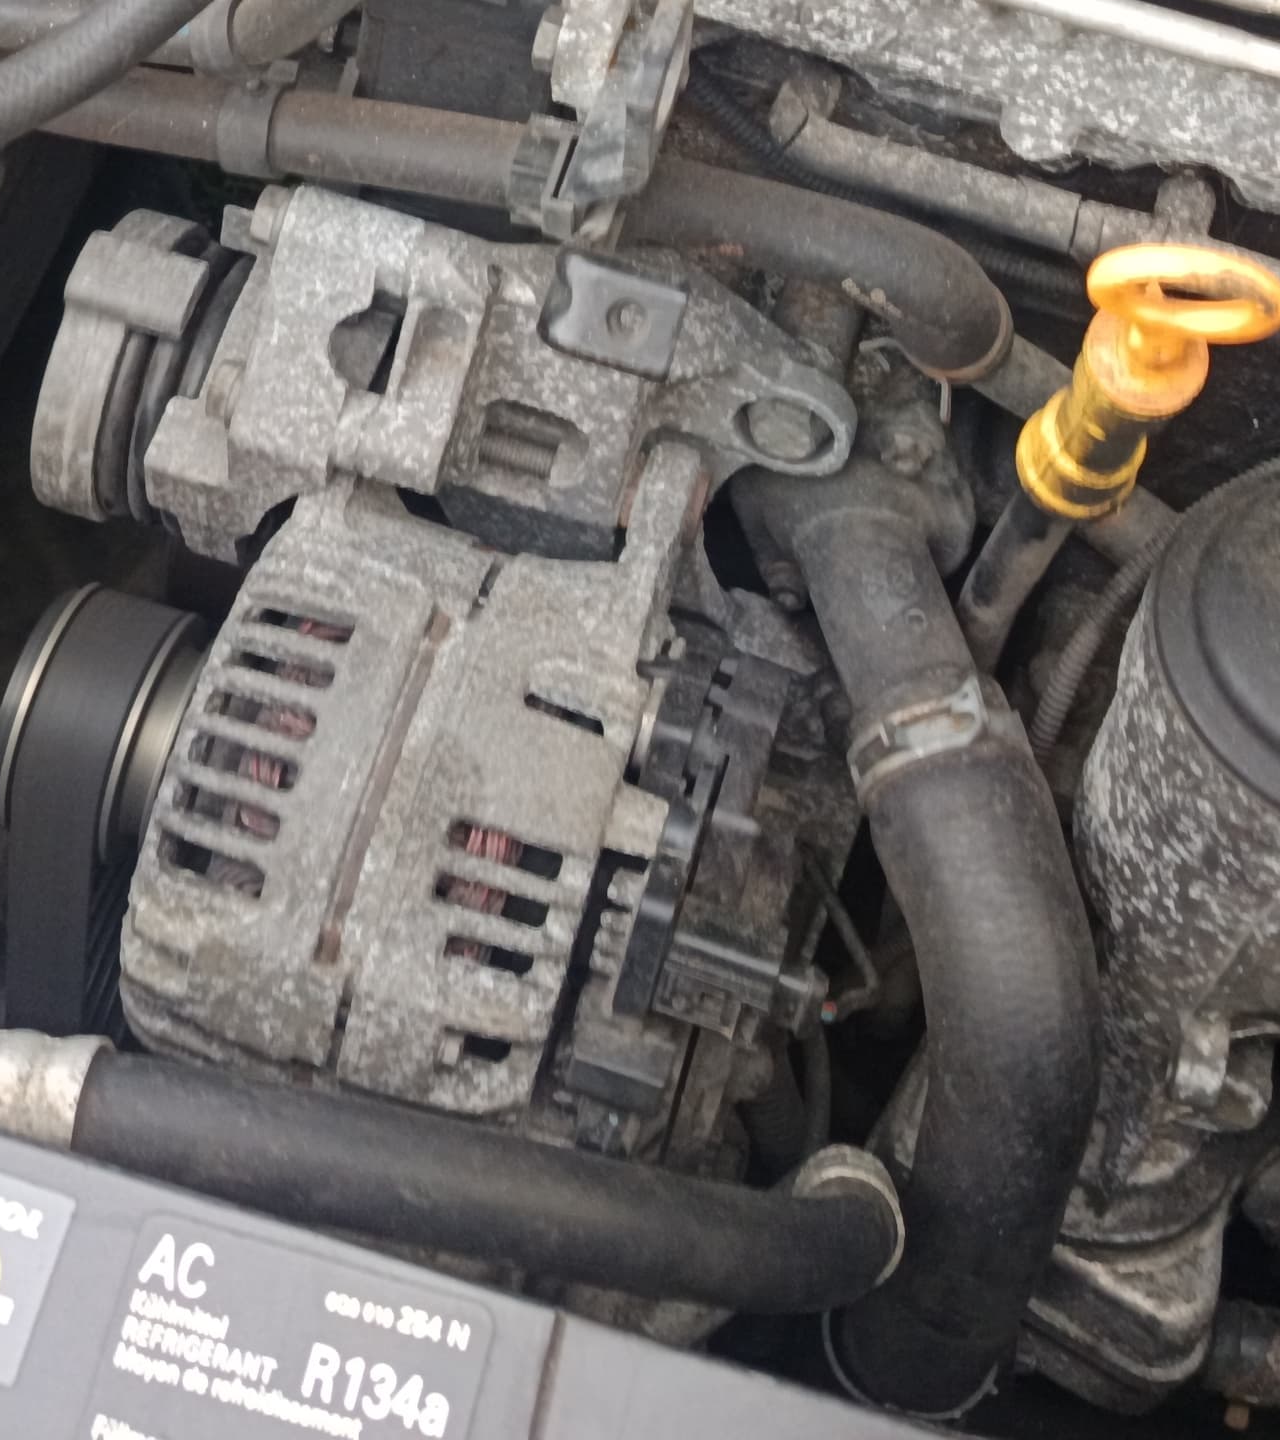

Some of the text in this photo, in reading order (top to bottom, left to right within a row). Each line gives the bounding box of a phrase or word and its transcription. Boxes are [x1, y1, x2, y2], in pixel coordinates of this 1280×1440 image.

[138, 1233, 215, 1299] AC
[113, 1341, 181, 1386] Moyen
[182, 1366, 209, 1395] de
[122, 1315, 279, 1385] REFRIGERANT
[446, 1319, 472, 1352] N
[300, 1342, 450, 1438] R134a
